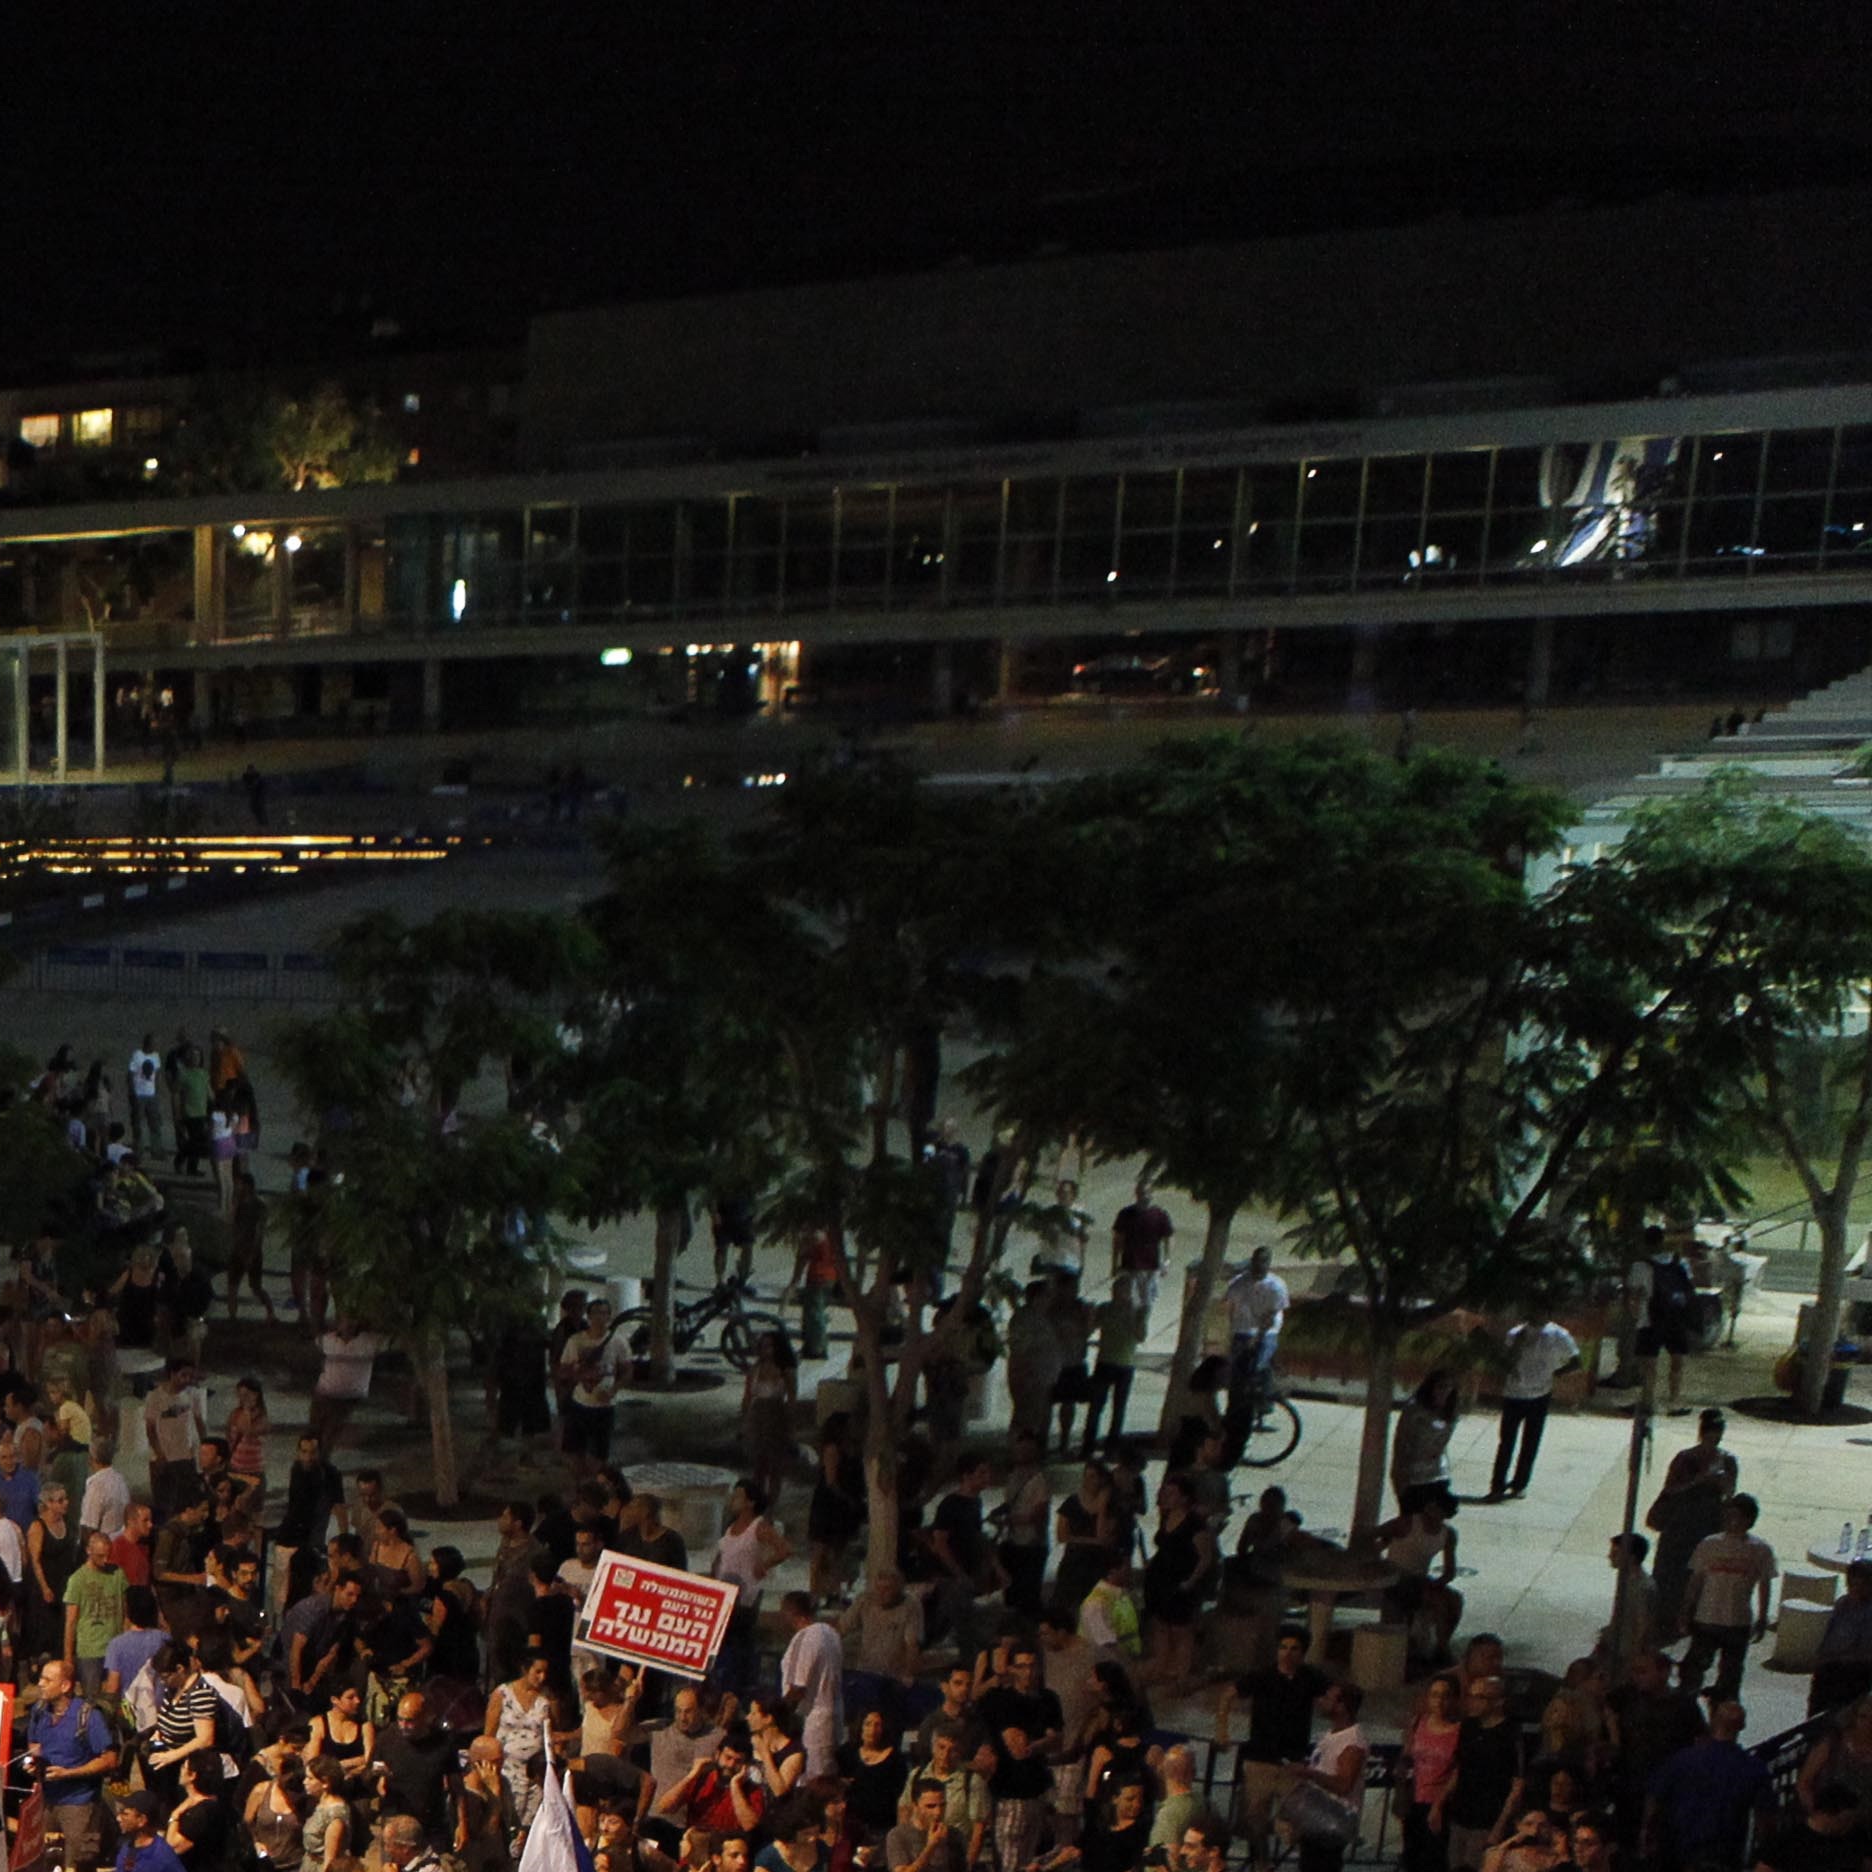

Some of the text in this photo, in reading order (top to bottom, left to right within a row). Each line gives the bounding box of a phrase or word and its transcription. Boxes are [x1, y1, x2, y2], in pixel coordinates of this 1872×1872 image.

[639, 1579, 718, 1608] כשהממשלה
[596, 1619, 703, 1659] הממשלה
[613, 1599, 709, 1640] העם נגד
